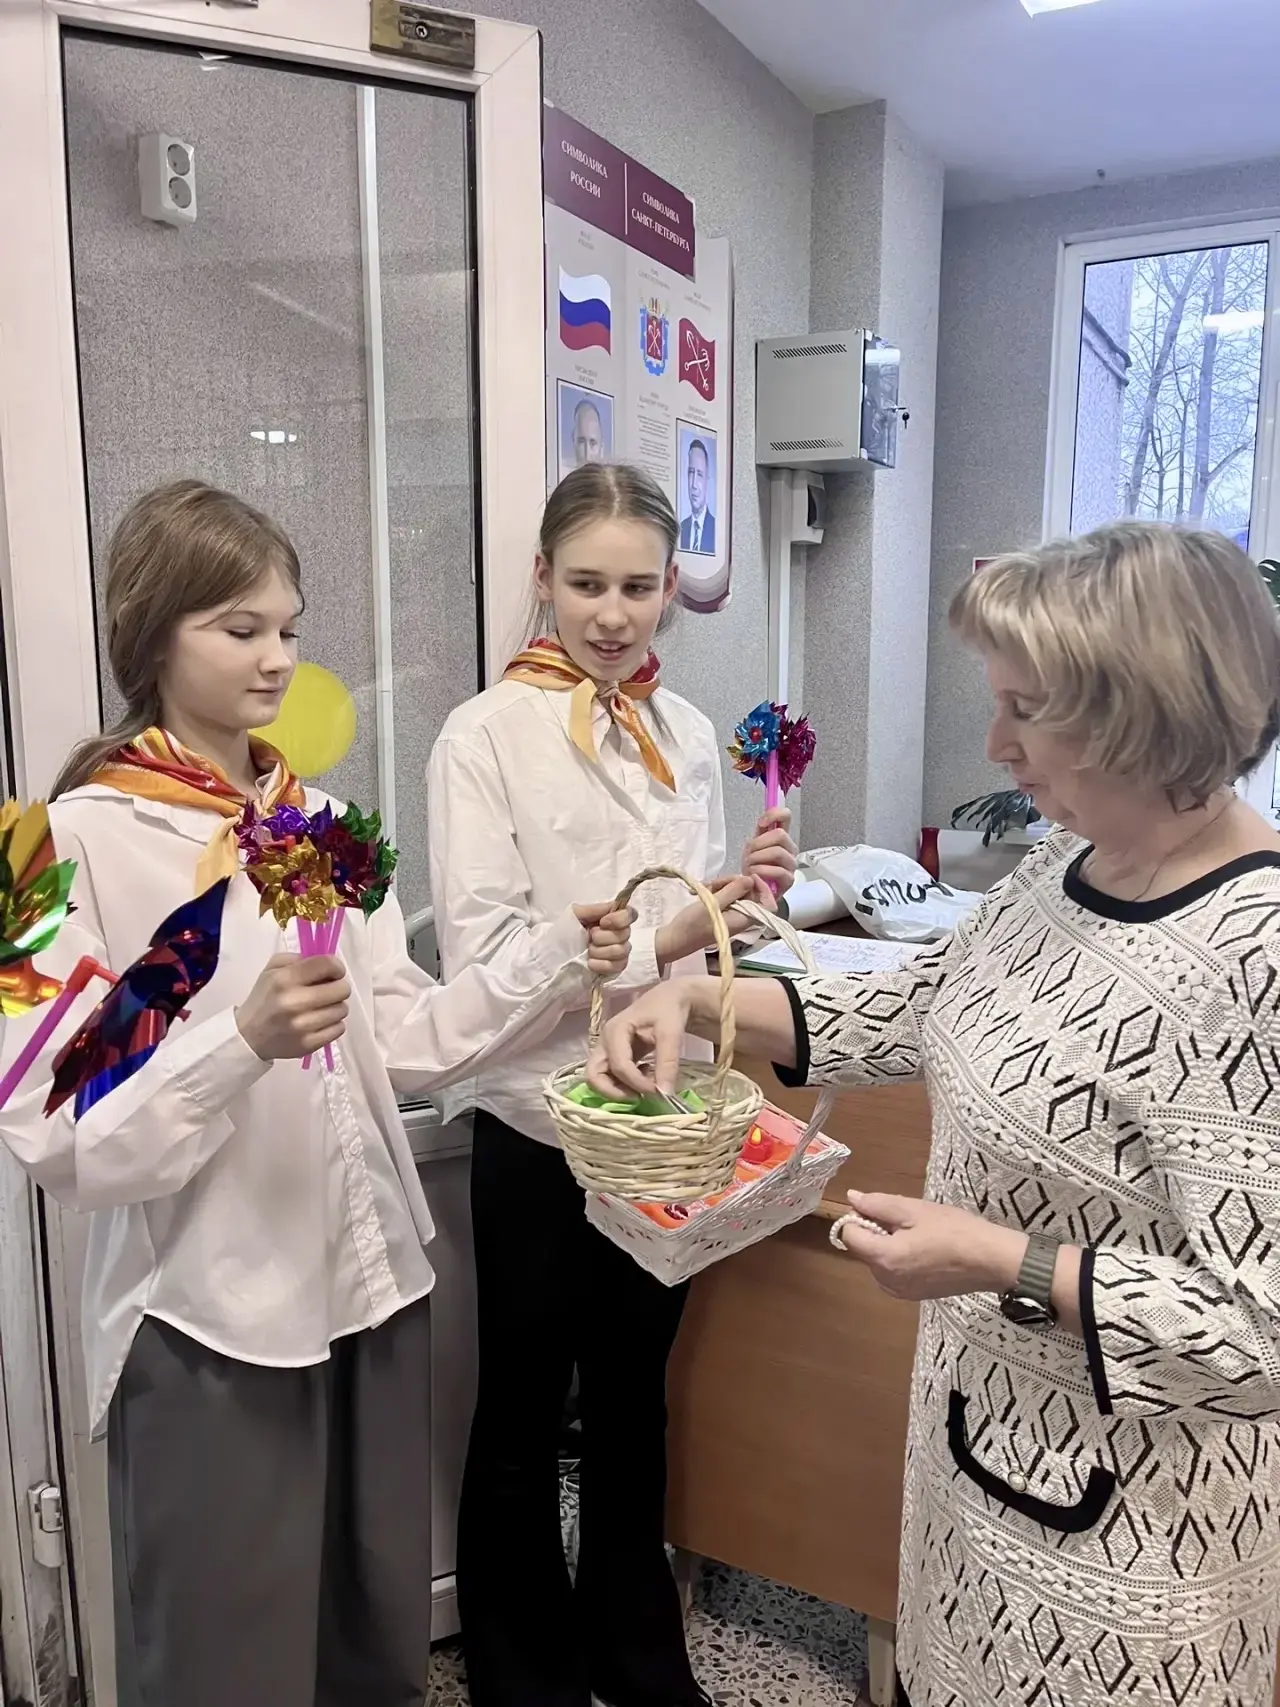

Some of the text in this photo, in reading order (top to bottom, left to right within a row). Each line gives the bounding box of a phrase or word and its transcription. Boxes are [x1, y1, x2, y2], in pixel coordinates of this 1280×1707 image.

[561, 139, 608, 179] СИМВОЛИКА
[570, 170, 601, 198] РОССИИ
[642, 192, 680, 224] СИМВОЛИКА
[631, 208, 690, 252] САНКТ-ПЕТЕРБУРГА
